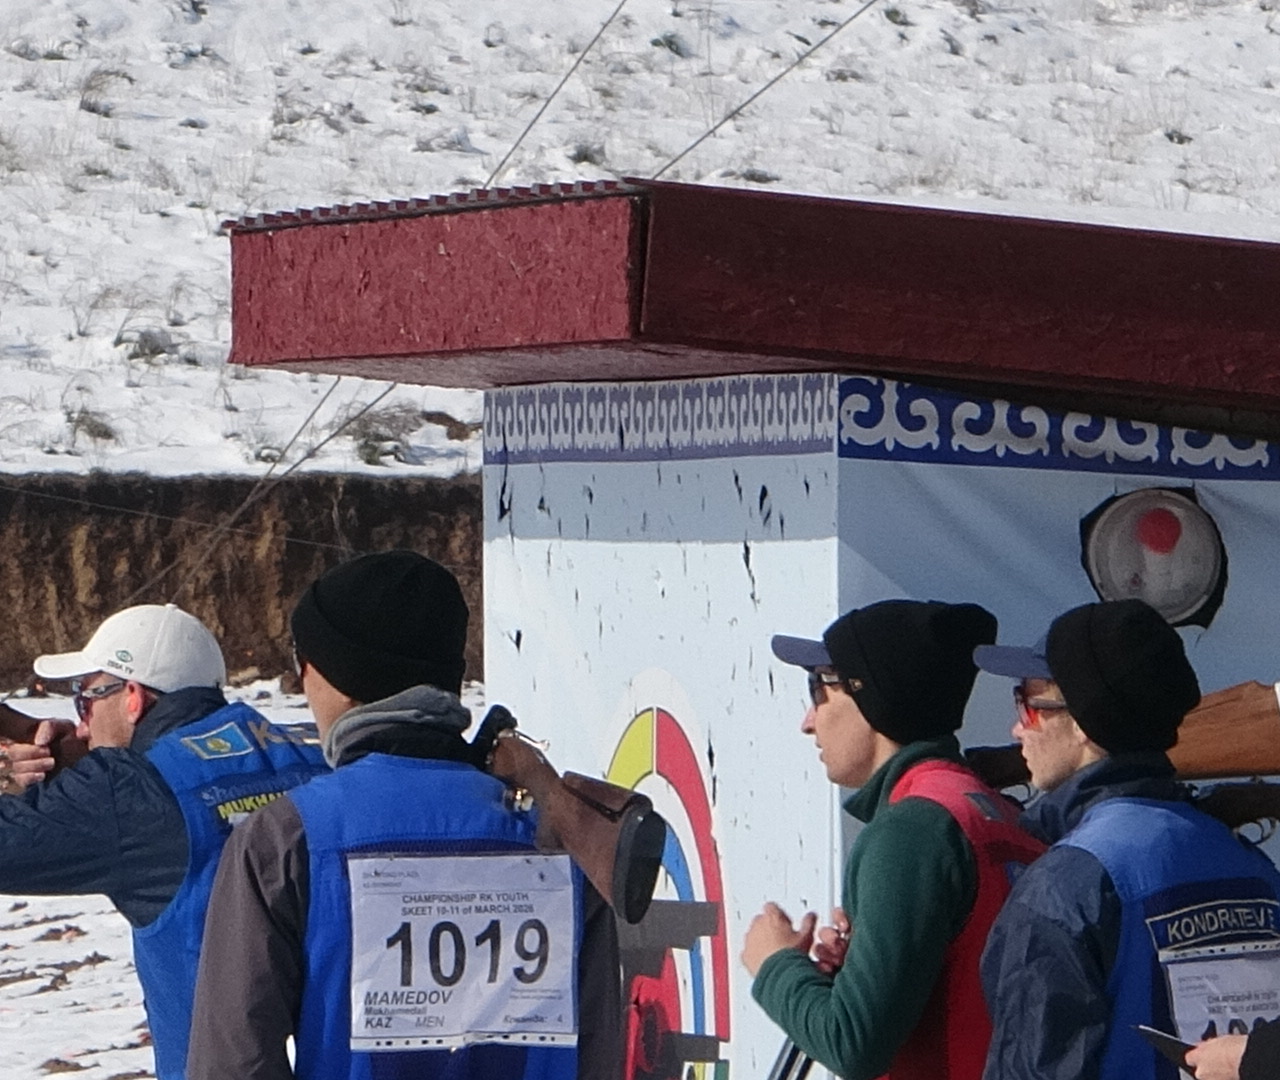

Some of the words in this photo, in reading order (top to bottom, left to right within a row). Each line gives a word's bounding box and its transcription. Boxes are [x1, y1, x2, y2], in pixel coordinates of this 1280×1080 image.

[402, 893, 477, 904] CHAMPIONSHIP
[480, 893, 493, 902] RK
[495, 892, 529, 902] YOUTH
[401, 905, 432, 916] SKEET
[462, 905, 472, 915] of
[474, 904, 511, 915] MARCH
[1167, 906, 1265, 943] KONDRATEV
[385, 918, 550, 987] 1019
[364, 990, 453, 1006] MAMEDOV
[365, 1017, 393, 1029] KAZ
[415, 1015, 445, 1028] MEN
